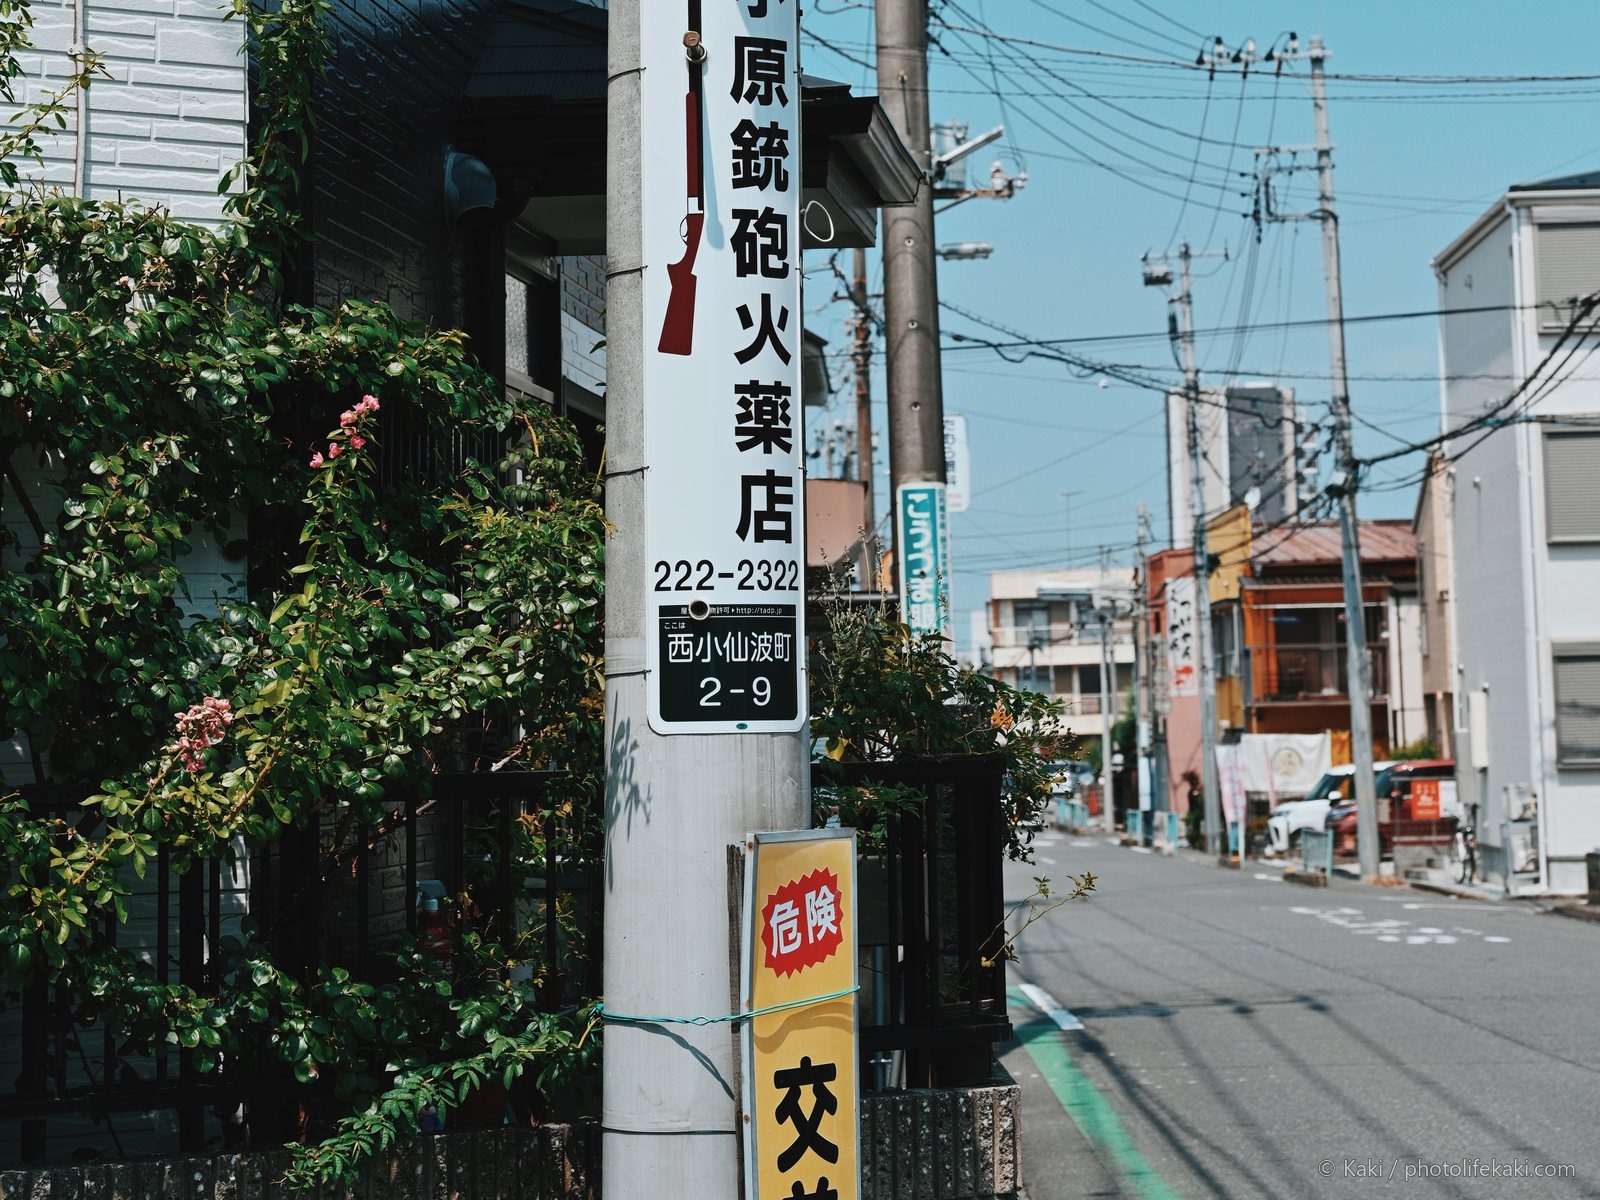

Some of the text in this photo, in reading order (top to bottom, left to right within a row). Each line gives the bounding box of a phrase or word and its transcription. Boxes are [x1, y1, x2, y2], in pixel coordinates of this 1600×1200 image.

[653, 559, 799, 592] 222-2322
[663, 621, 687, 630] ここは
[680, 606, 730, 615] 屋物許可
[667, 631, 792, 663] 西小仙波町
[699, 676, 772, 707] 2-9
[769, 885, 839, 958] 危険
[773, 1055, 840, 1200] 交
